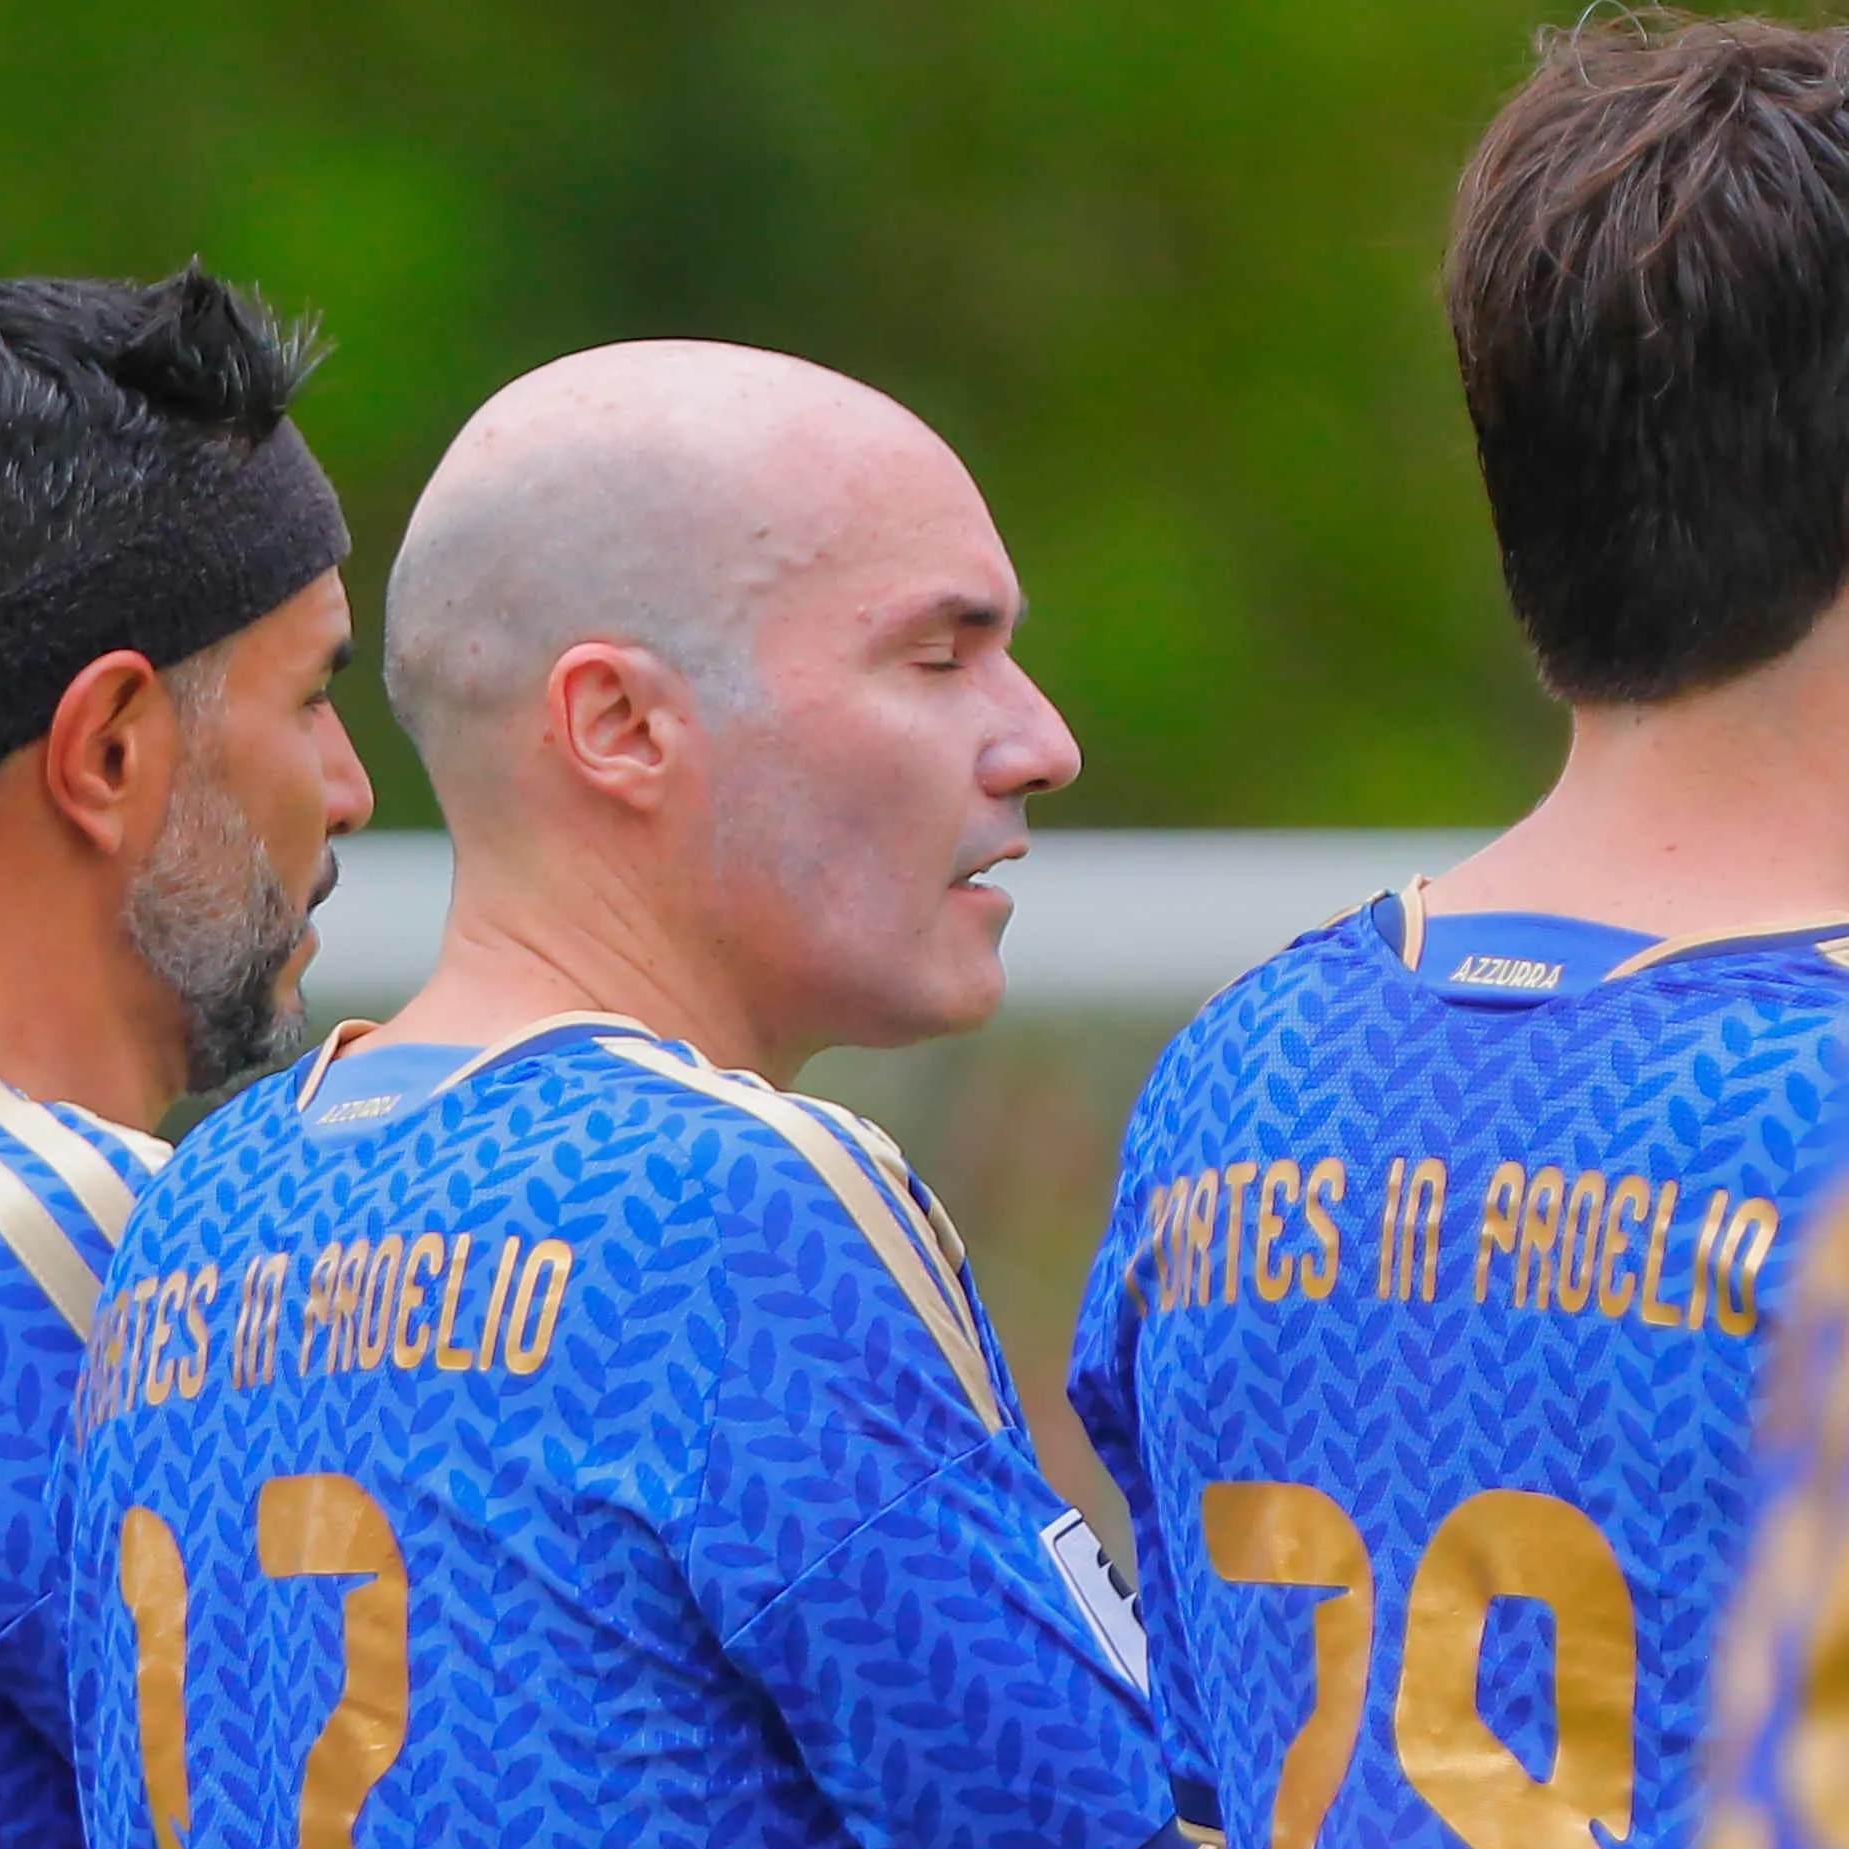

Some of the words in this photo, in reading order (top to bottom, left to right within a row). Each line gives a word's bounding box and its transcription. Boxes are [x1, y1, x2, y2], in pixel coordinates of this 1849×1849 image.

[1450, 955, 1564, 989] AZZURRA
[232, 1252, 290, 1391] IN
[299, 1231, 574, 1376] PROELIO
[1376, 1156, 1448, 1304] IN
[1474, 1160, 1780, 1337] PROELIO
